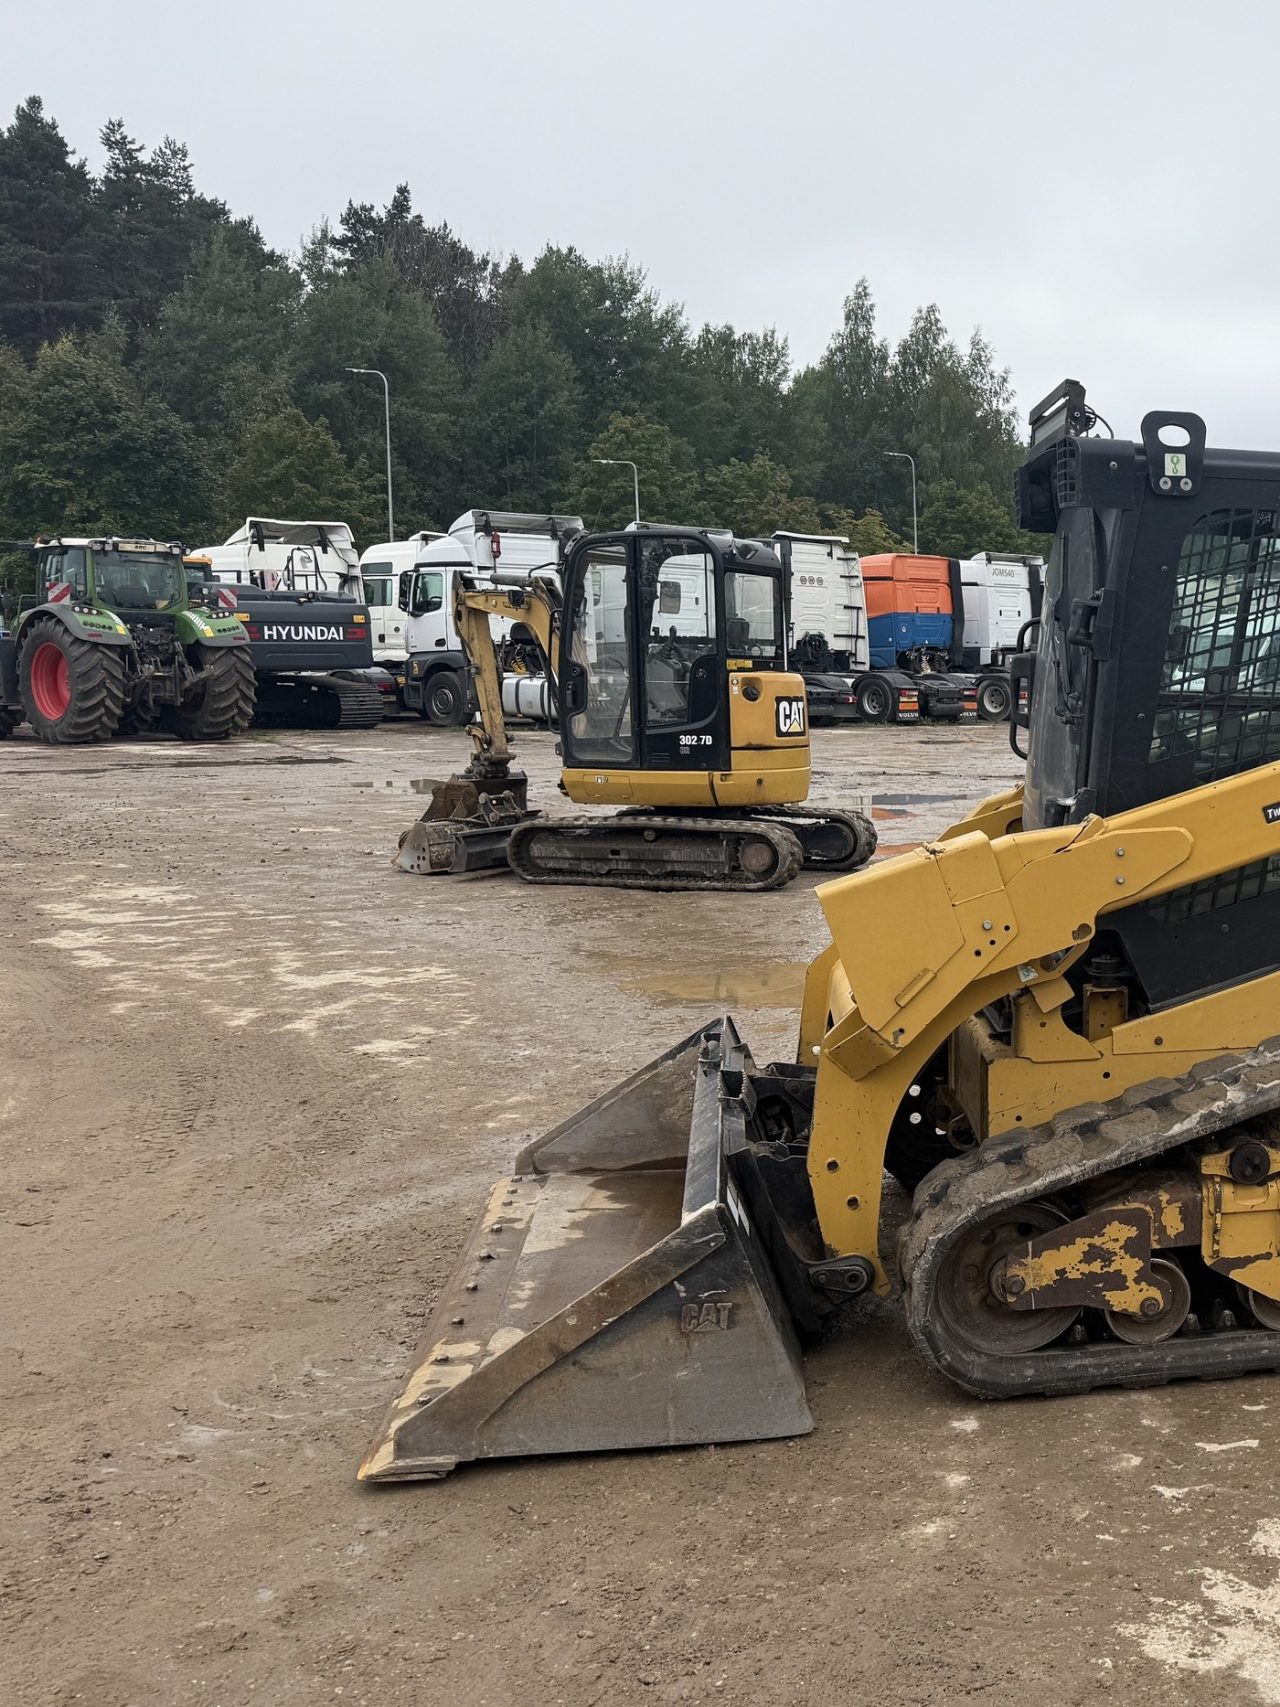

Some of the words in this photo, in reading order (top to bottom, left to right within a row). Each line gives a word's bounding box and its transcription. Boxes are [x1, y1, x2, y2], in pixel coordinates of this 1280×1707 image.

[263, 625, 344, 641] HYUNDAI
[779, 700, 804, 733] CAT
[679, 735, 713, 745] 302.7D
[681, 1303, 733, 1333] CAT
